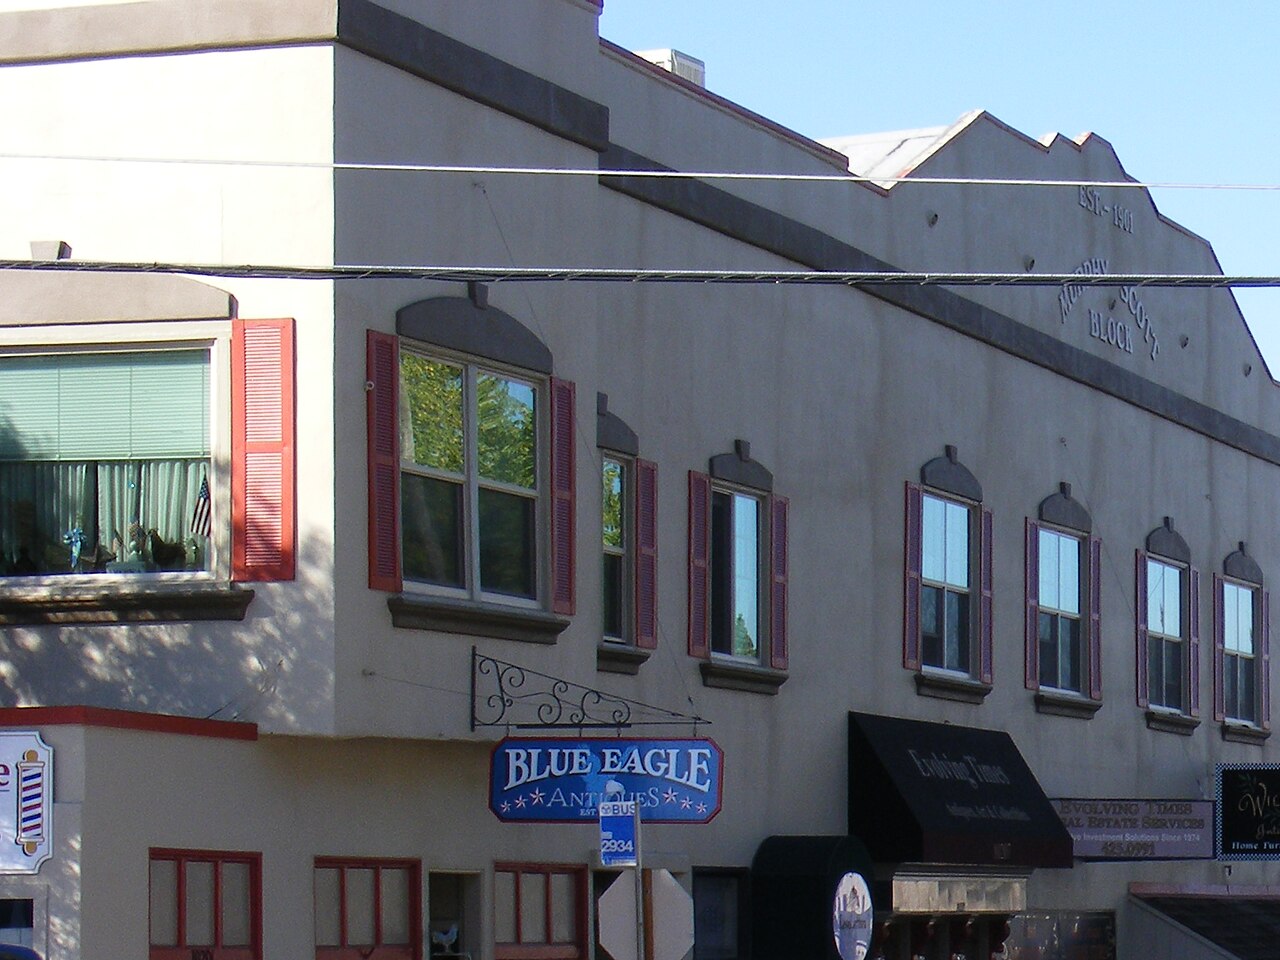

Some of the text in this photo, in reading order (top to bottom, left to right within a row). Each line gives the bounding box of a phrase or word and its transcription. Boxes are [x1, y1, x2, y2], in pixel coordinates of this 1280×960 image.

[1088, 308, 1134, 354] BLOCK
[1120, 285, 1160, 361] SCOTT
[503, 748, 712, 793] BLUE EAGLE
[963, 755, 1011, 785] Times
[546, 786, 660, 808] ANTIQUES
[612, 804, 636, 815] BUS
[601, 839, 634, 853] 2934
[1232, 841, 1260, 851] Home
